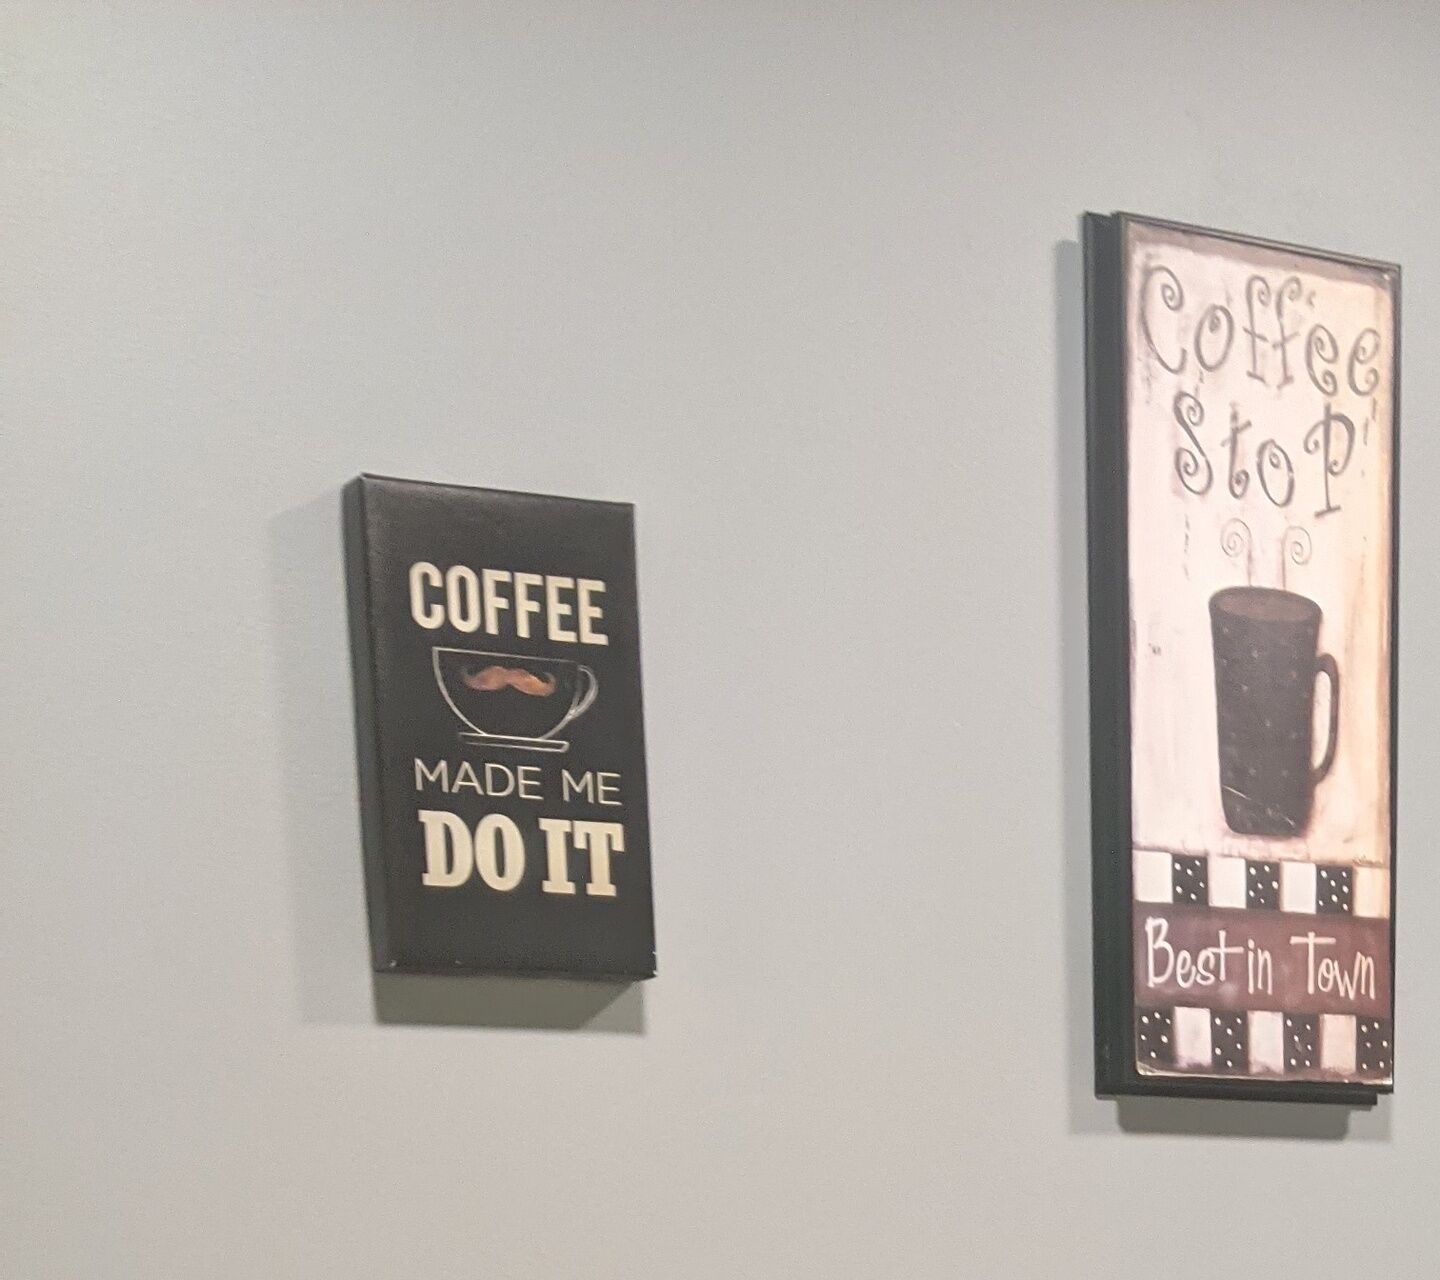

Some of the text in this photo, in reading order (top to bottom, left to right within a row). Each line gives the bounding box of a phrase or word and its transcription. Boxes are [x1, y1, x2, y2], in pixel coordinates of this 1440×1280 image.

[1140, 264, 1382, 398] Coffee
[408, 561, 610, 646] COFFEE
[414, 758, 623, 806] MADE ME
[418, 809, 625, 897] DO IT
[1145, 916, 1376, 1001] Best in Town
